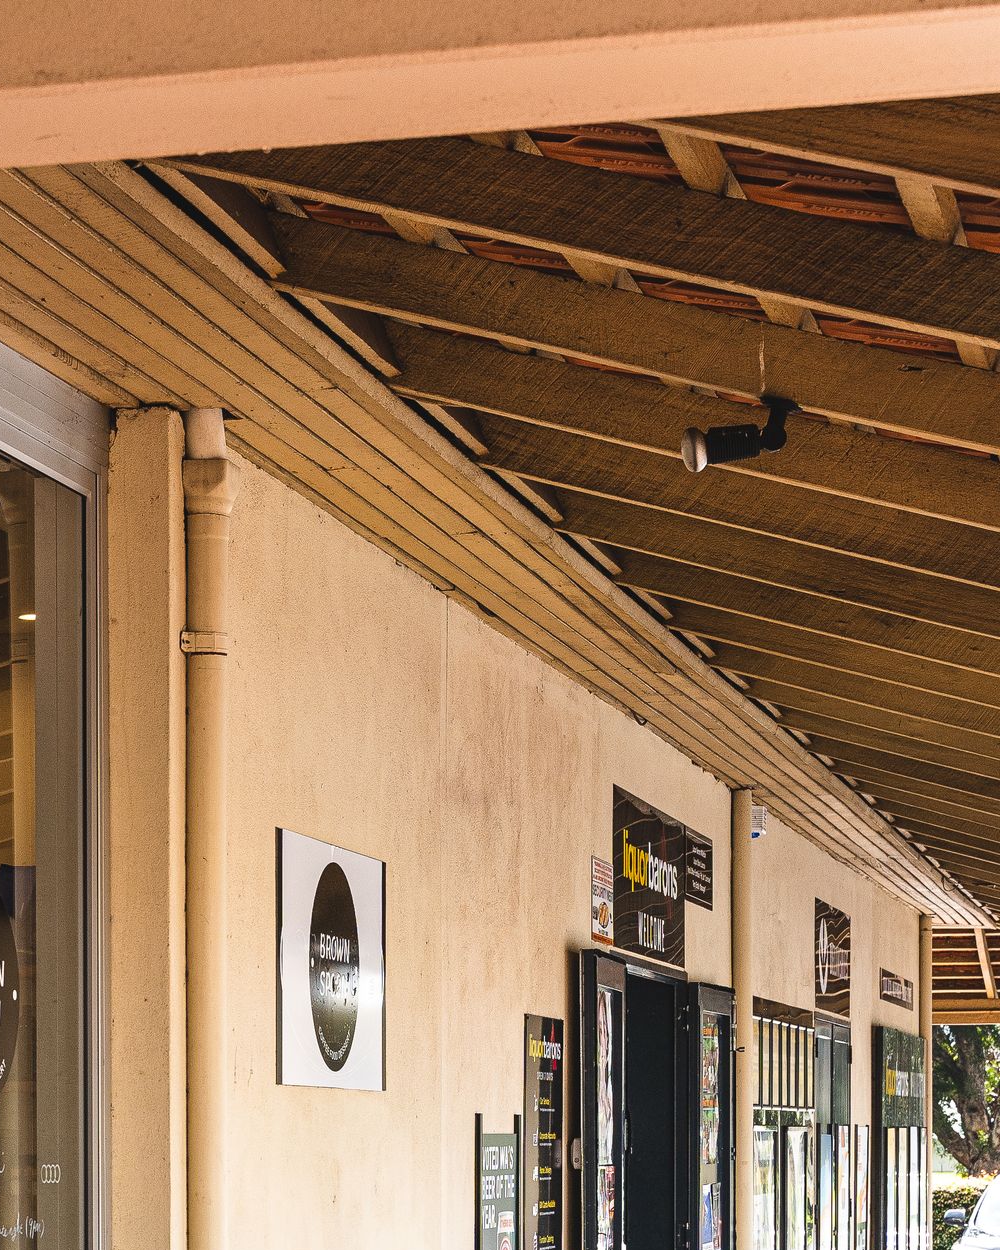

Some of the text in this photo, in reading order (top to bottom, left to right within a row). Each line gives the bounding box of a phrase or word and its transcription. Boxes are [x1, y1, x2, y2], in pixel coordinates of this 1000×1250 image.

[623, 828, 678, 900] liquorbarons
[320, 933, 350, 963] BROWN
[638, 911, 664, 953] WELCOME
[482, 1147, 498, 1170] VOTED
